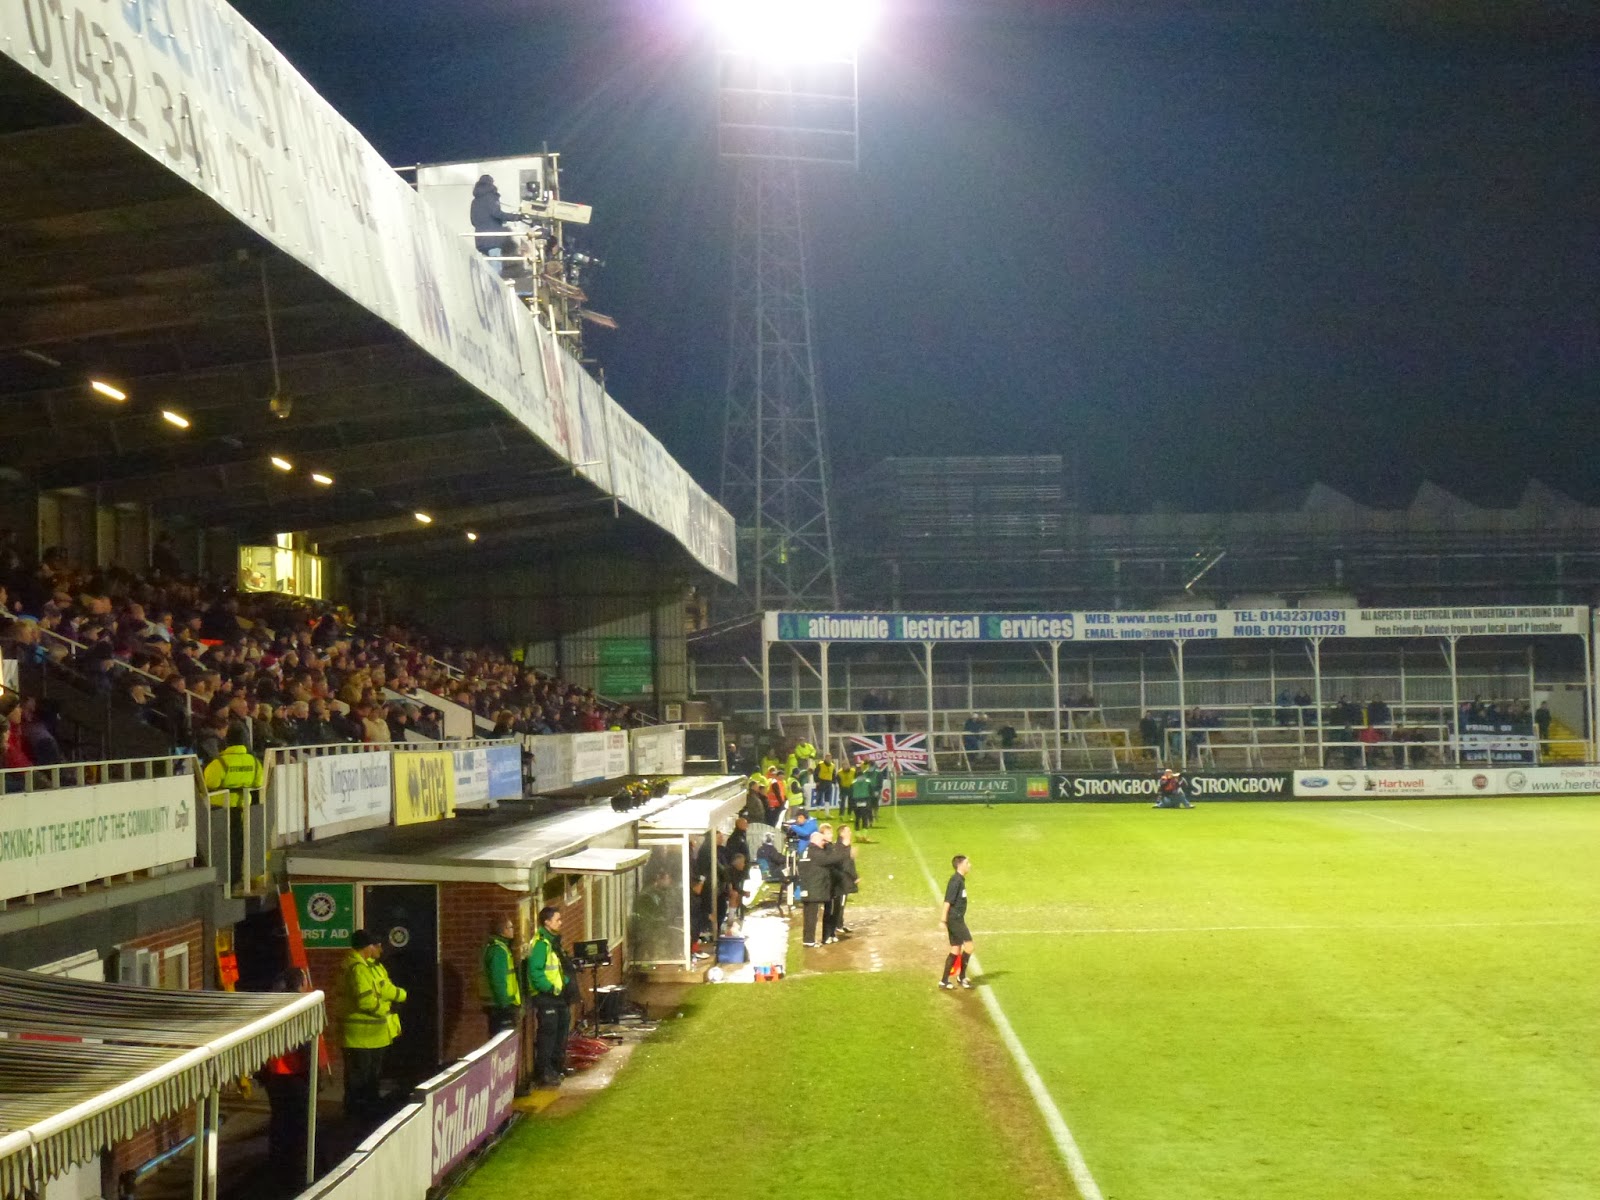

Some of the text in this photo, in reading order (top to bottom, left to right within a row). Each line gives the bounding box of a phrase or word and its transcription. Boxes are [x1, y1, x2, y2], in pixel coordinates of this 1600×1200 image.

[1085, 613, 1217, 624] WEB: www.nes-ltd.org
[1234, 610, 1346, 622] TEL: 01432370391
[1373, 610, 1402, 621] ASPECTS
[1412, 609, 1450, 620] ELECTRICAL
[1452, 609, 1472, 619] WORK
[1553, 607, 1574, 618] SOLAR
[798, 614, 889, 639] Nationwide
[988, 615, 1074, 639] Services
[1234, 626, 1265, 636] MOB:
[1375, 625, 1391, 635] Free
[1393, 625, 1422, 636] Friendly
[1424, 625, 1449, 635] Advice
[1451, 624, 1468, 634] from
[1470, 625, 1486, 635] your
[1487, 623, 1507, 633] local
[1084, 628, 1118, 639] EMAIL:
[933, 779, 1009, 791] TAYLOR LANE
[1191, 776, 1284, 796] STRONGBOW
[1378, 779, 1425, 788] Hartwell
[35, 826, 47, 855] AT
[48, 823, 67, 851] THE
[68, 818, 96, 849] HEART
[97, 815, 108, 842] OF
[110, 813, 126, 840] THE
[128, 806, 170, 837] COMMUNITY
[330, 928, 349, 939] AID
